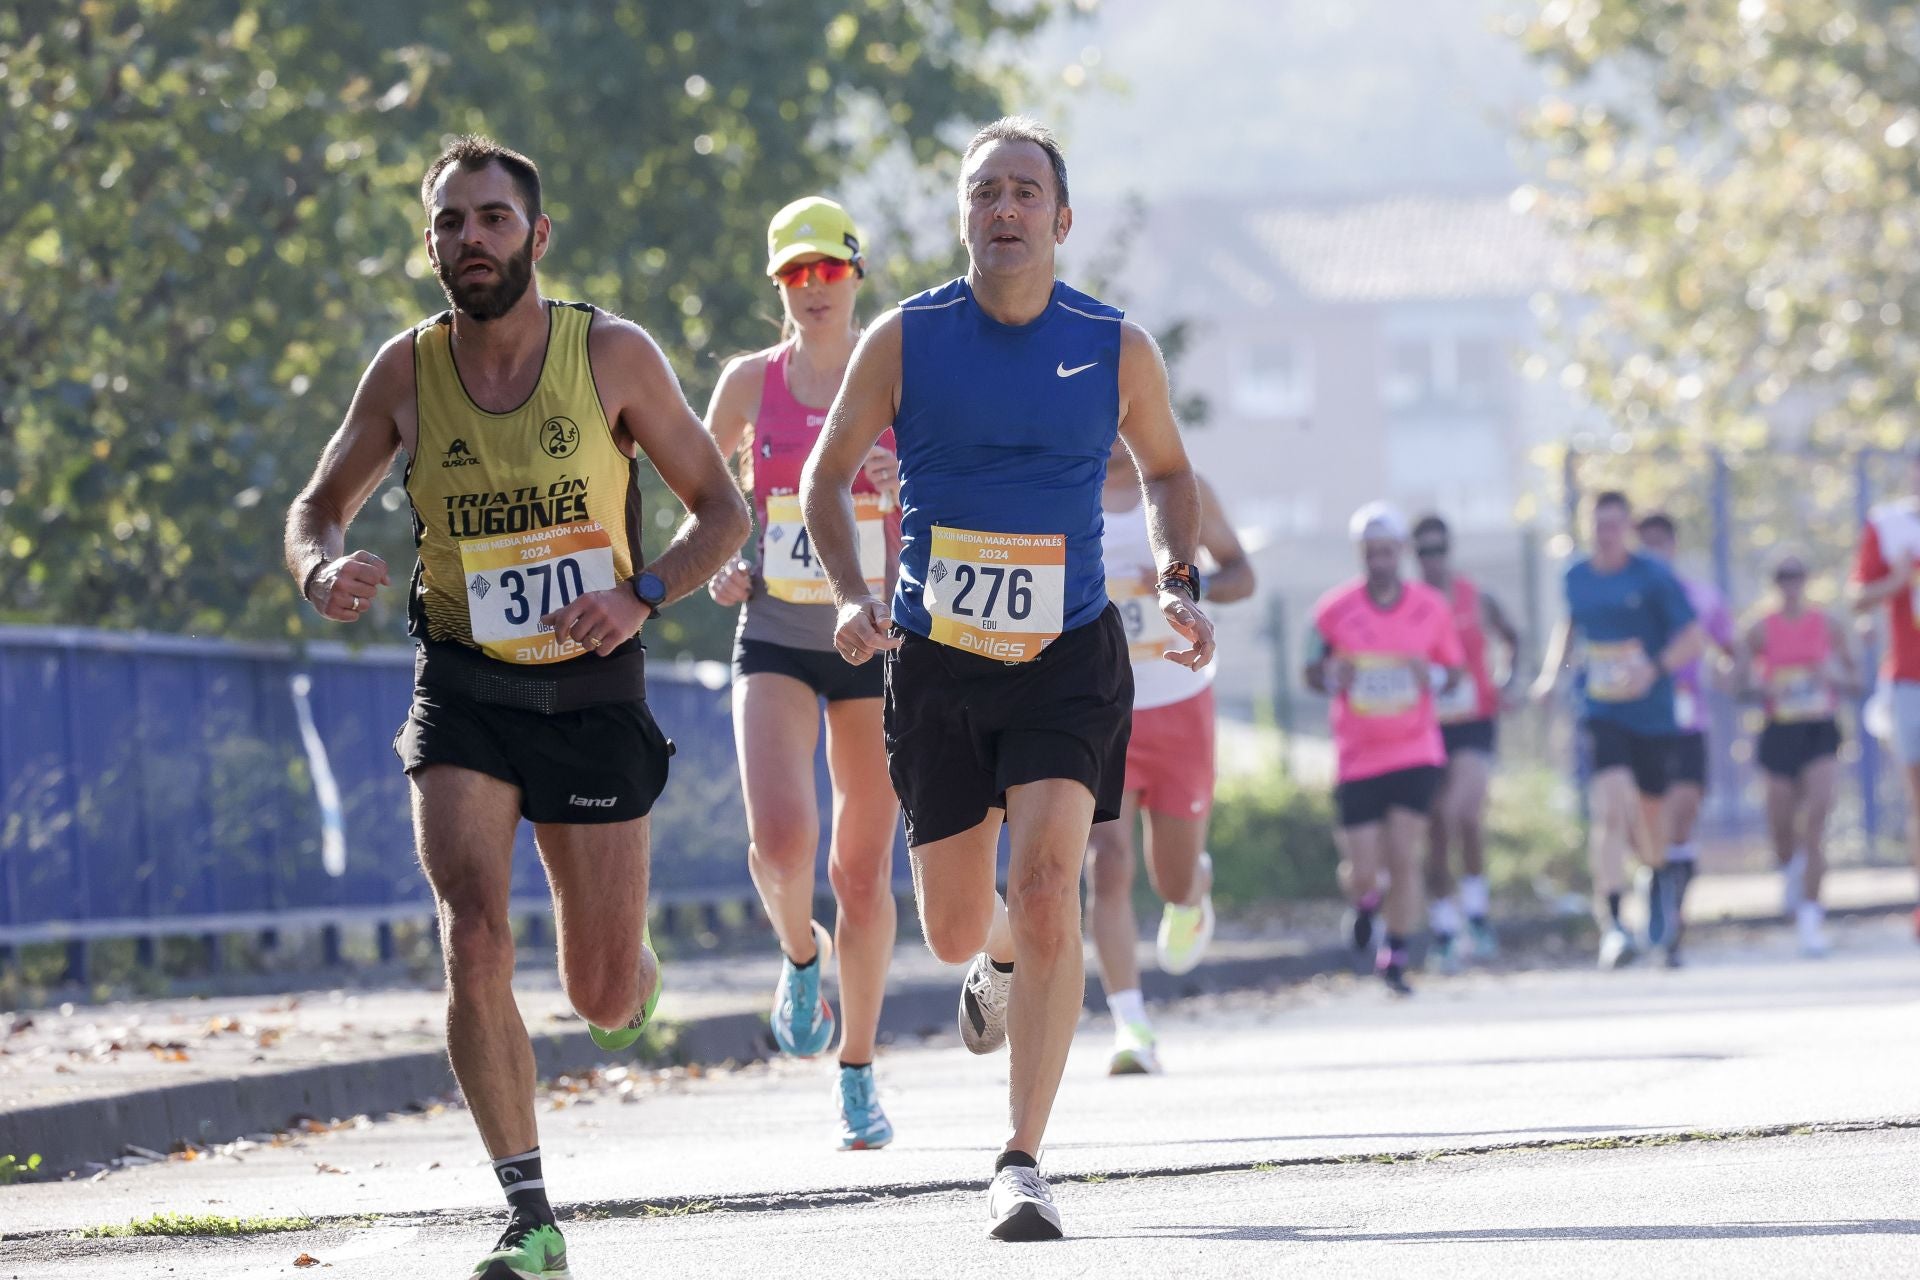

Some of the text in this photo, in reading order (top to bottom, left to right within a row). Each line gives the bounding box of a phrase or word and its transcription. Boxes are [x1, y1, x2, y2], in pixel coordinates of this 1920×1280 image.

[443, 475, 589, 509] TRIATLÓN
[448, 492, 590, 537] LUGONES
[491, 538, 521, 549] MEDIA
[523, 526, 572, 545] MARATÓN
[957, 533, 983, 544] MEDIA
[984, 536, 1032, 547] MARATÓN
[1032, 536, 1062, 547] AVILÉS
[520, 545, 551, 560] 2024
[979, 549, 1008, 560] 2024
[500, 558, 585, 625] 370
[952, 564, 1033, 621] 276
[982, 621, 997, 630] EDU
[960, 632, 1025, 657] avilés
[569, 794, 618, 807] land
